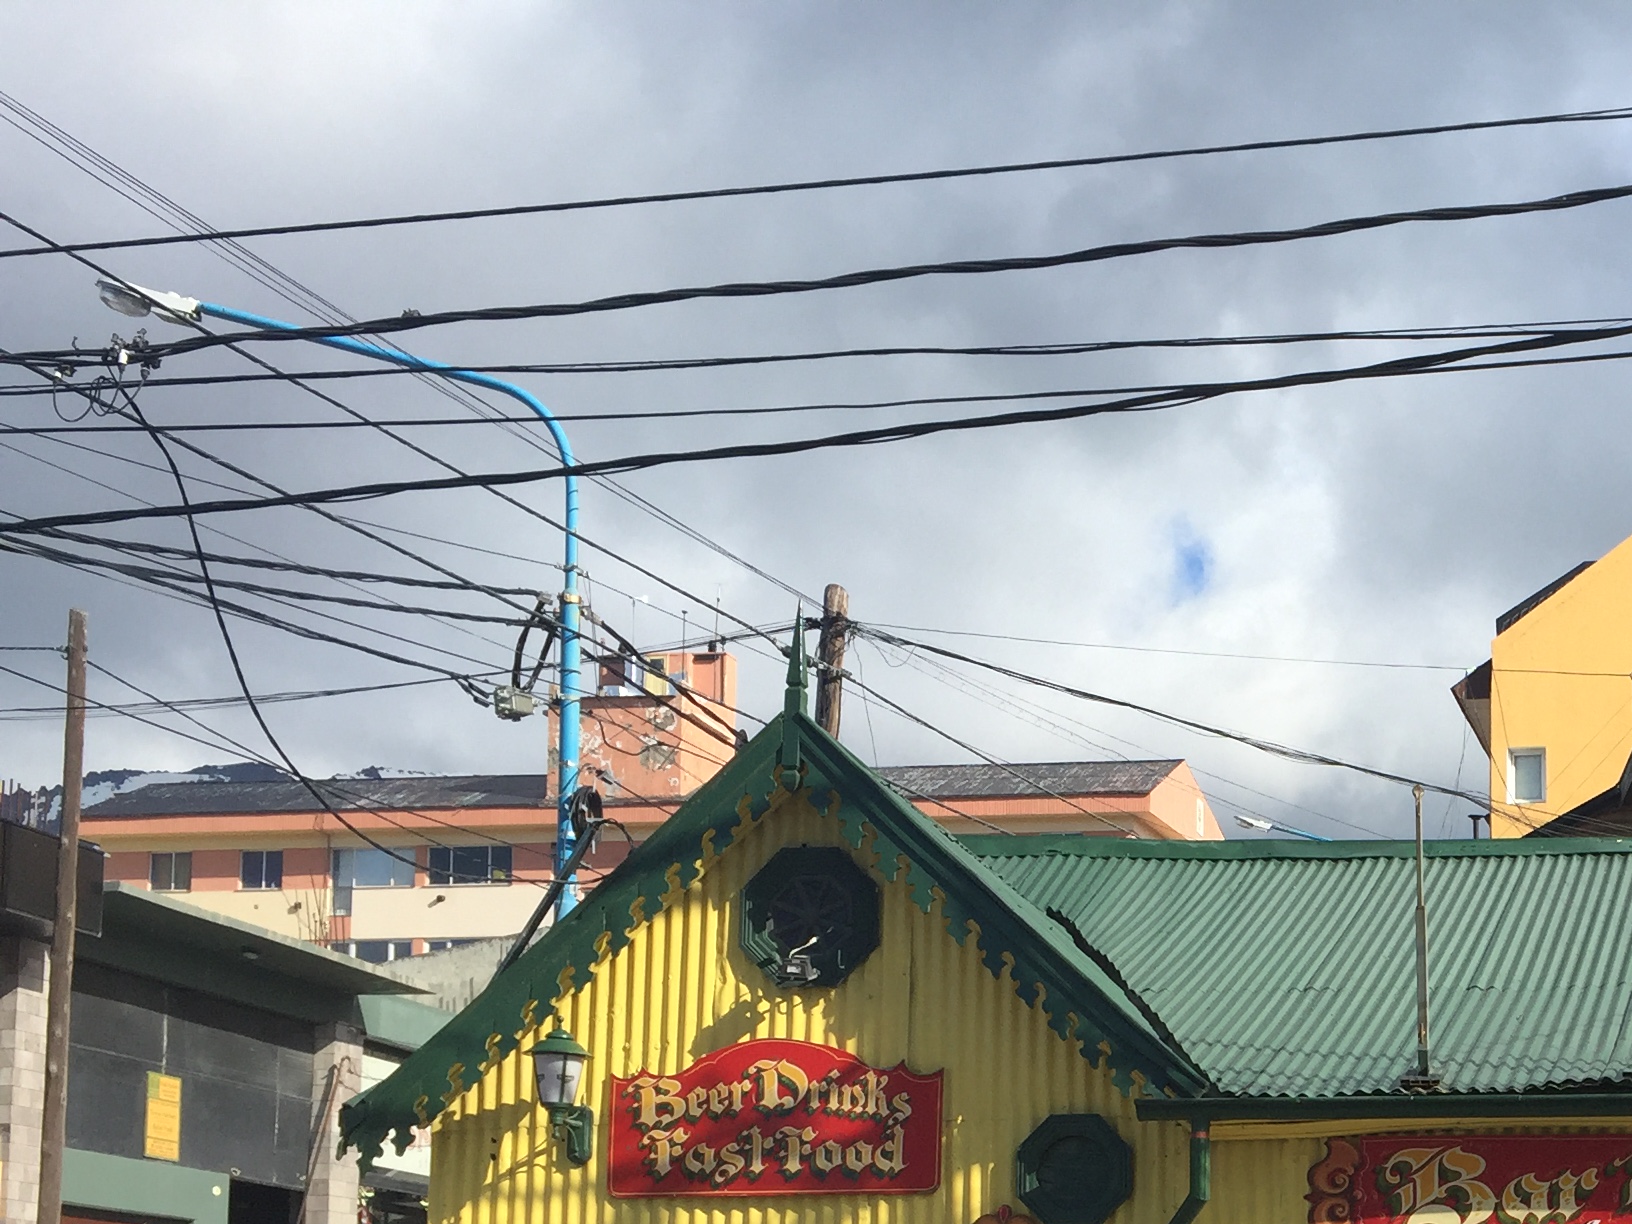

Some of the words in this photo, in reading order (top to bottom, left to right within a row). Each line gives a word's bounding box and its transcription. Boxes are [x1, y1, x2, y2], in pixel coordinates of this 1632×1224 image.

[627, 1076, 752, 1127] Beer
[748, 1059, 912, 1126] Drinks
[642, 1125, 775, 1184] Fast
[775, 1124, 909, 1174] Food
